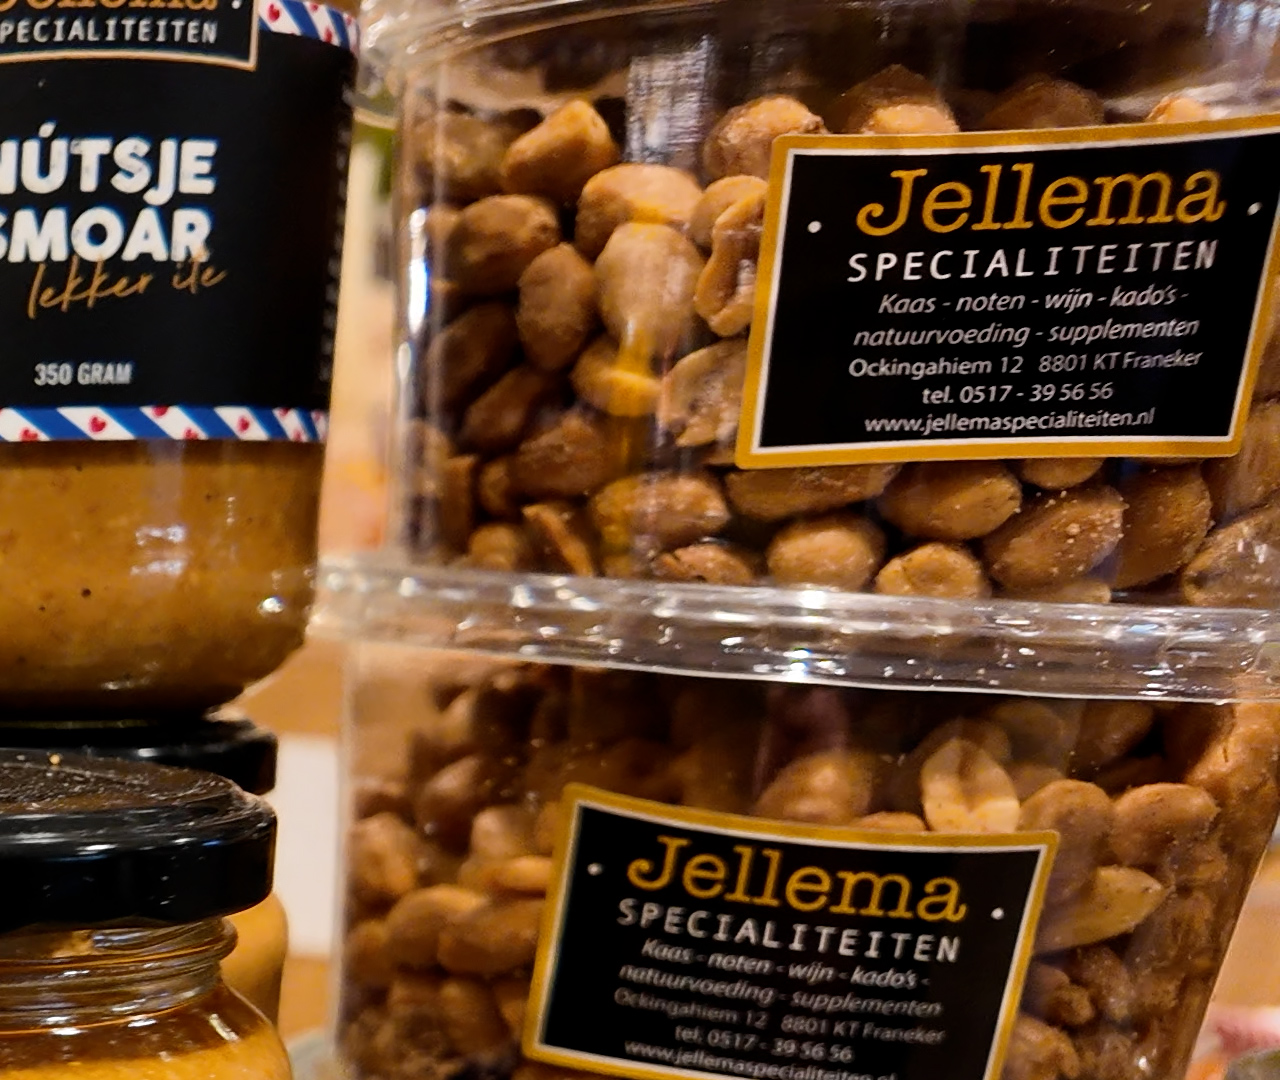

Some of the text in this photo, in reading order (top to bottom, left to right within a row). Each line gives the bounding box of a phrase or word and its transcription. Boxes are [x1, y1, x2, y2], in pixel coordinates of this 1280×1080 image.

[855, 163, 1228, 237] Jellema
[847, 240, 1218, 283] SPECIALITEITEN
[26, 254, 155, 320] lekker
[878, 283, 1178, 314] Kaas noten wijn kado's
[853, 318, 1200, 348] natuurvoeding supplementen
[33, 362, 132, 386] 350 GRAM
[848, 349, 1204, 380] Ockingahiem 12 8801 KT Franeker
[922, 382, 1114, 404] tel. 0517 39 56 56
[864, 407, 1156, 436] www.jellemaspecialiteiten.nl
[627, 834, 967, 923] Jellema
[616, 898, 961, 963] SPECIALITEITEN
[642, 937, 919, 989] Kaas noten wijn kado's
[619, 964, 943, 1017] natuurvoeding supplementen
